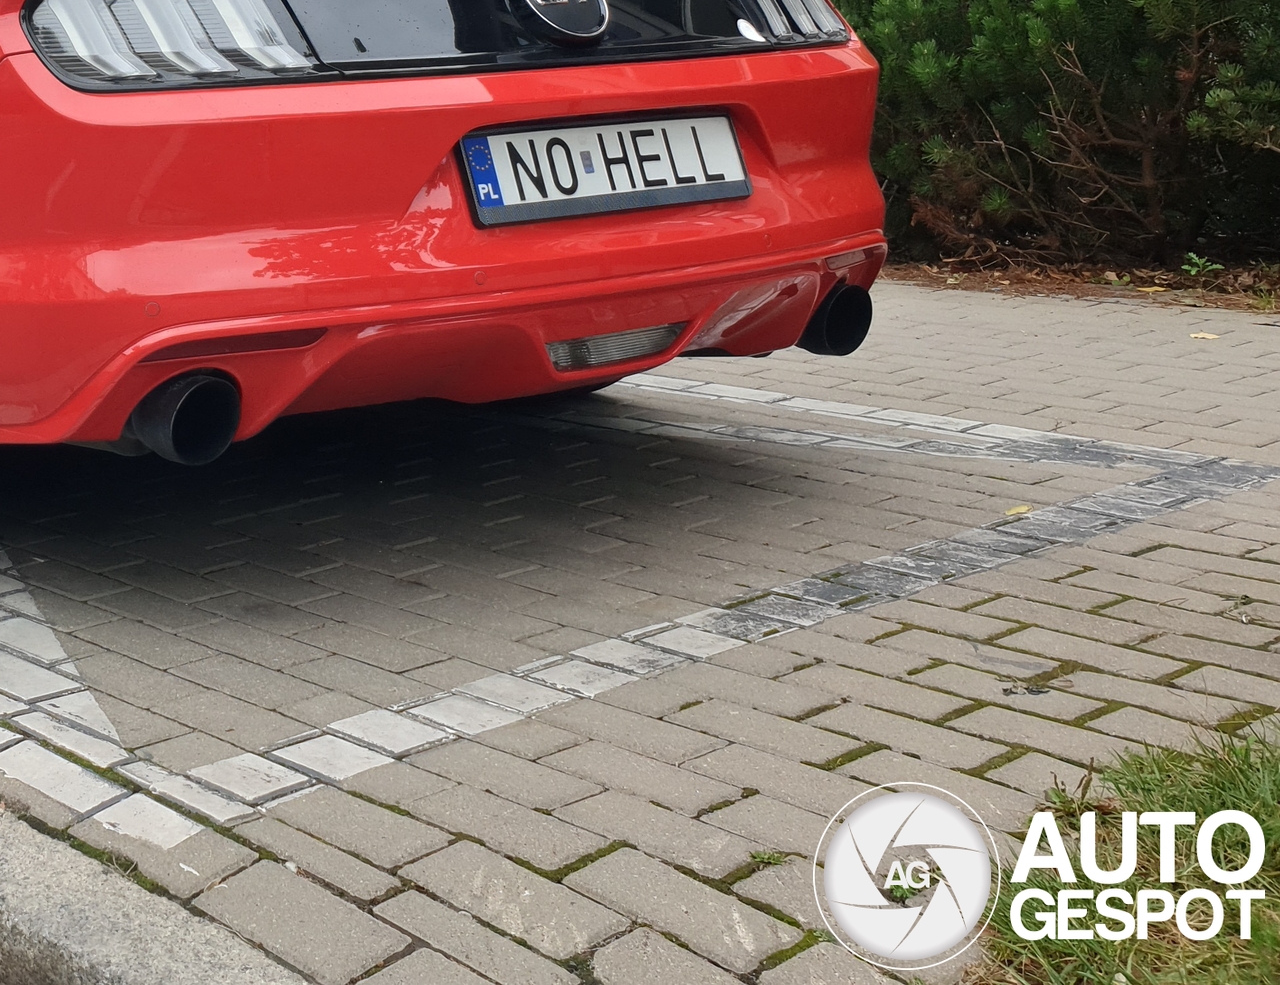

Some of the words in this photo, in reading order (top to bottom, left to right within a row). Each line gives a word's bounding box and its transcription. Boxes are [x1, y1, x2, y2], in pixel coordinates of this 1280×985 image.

[505, 136, 579, 202] NO
[596, 125, 726, 191] HELL
[477, 182, 499, 201] PL
